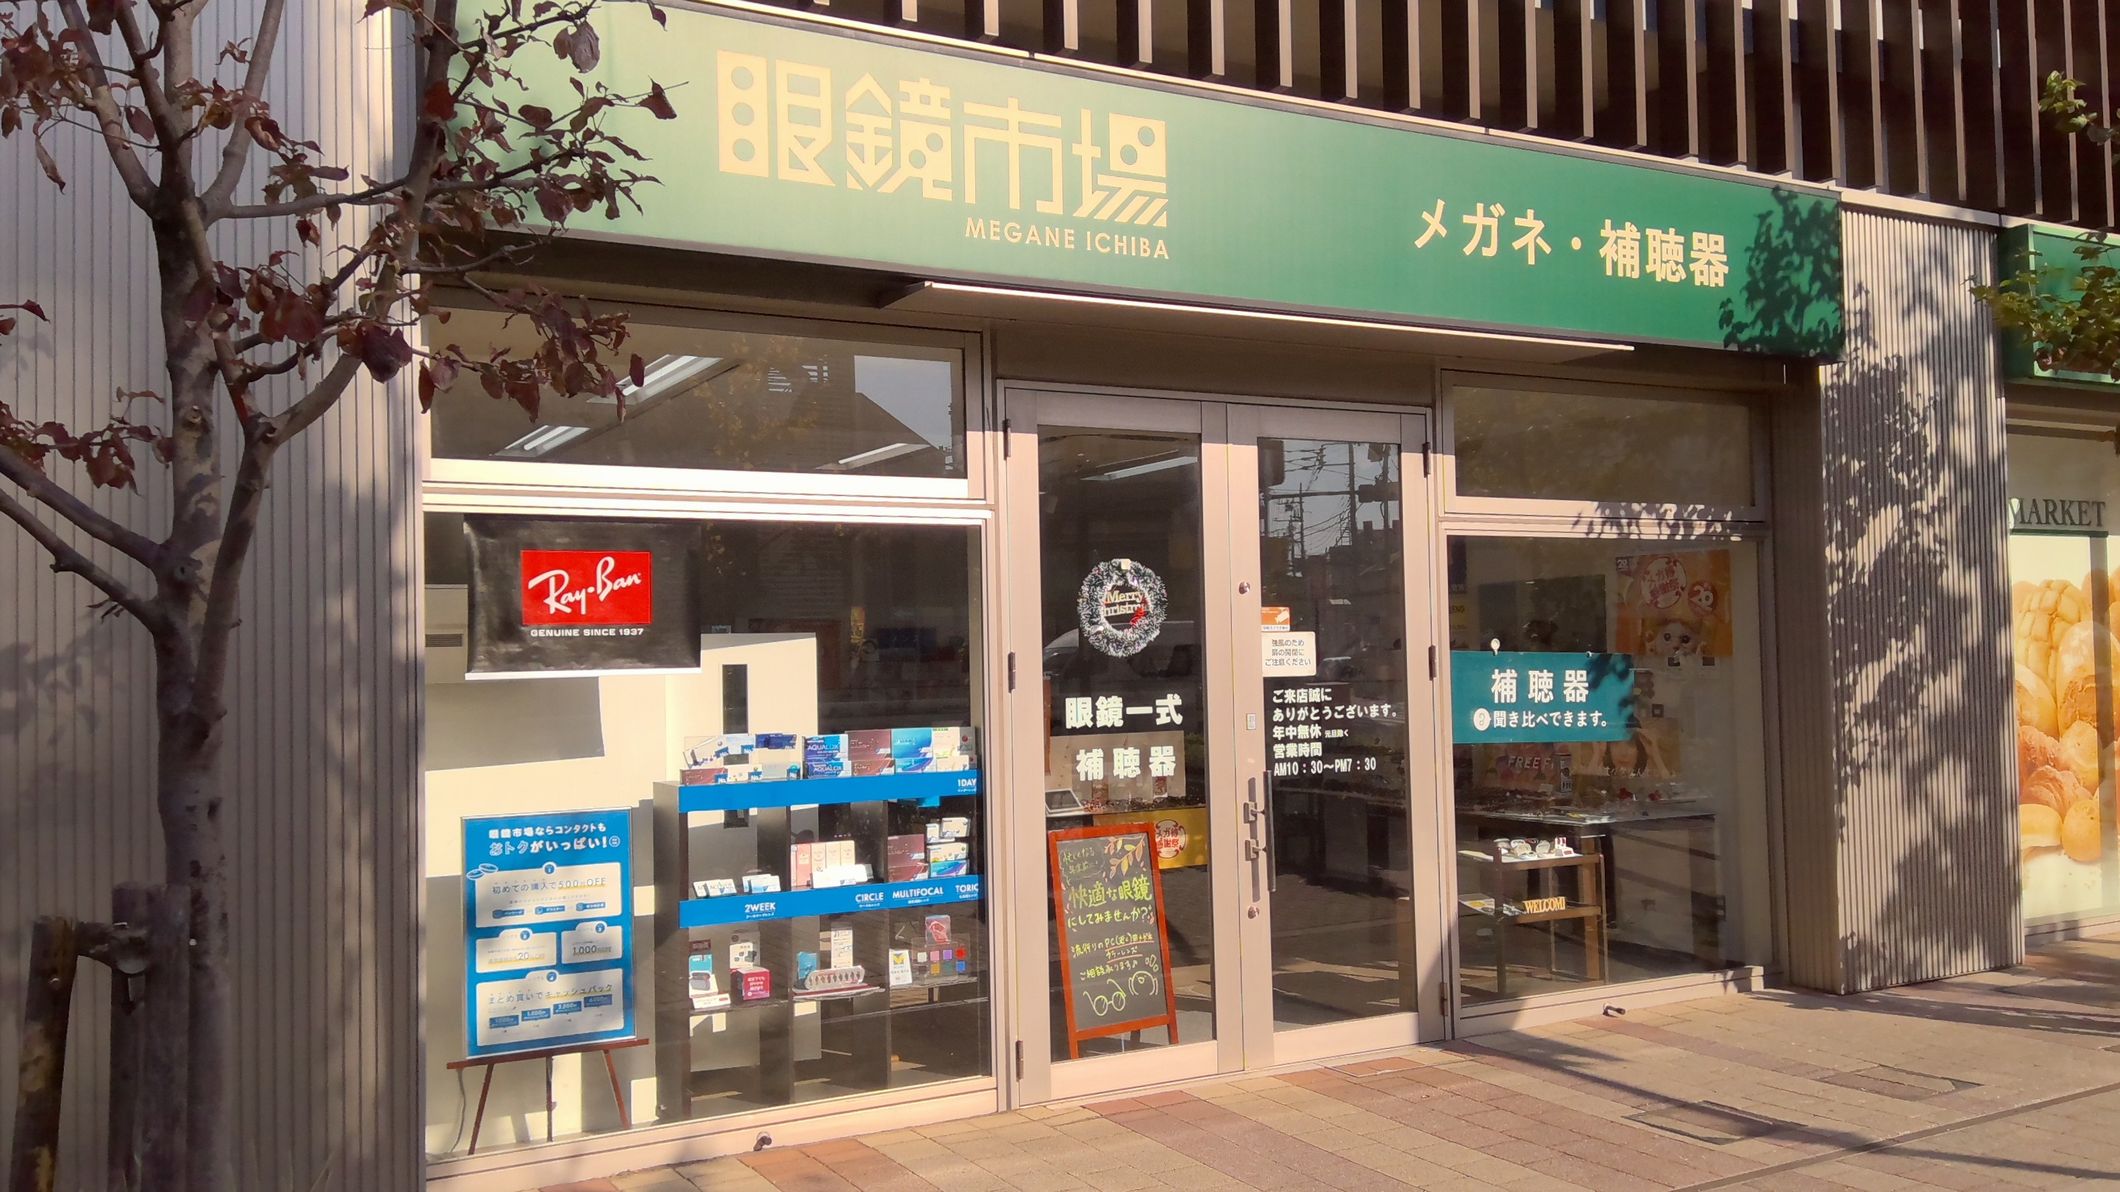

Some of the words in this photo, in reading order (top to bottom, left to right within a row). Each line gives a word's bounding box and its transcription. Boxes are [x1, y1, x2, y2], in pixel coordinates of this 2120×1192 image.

[717, 50, 1168, 227] 眼鏡市場
[965, 216, 1075, 249] MEGANE
[1086, 231, 1169, 259] ICHIBA
[2009, 497, 2106, 527] MARKET
[1103, 589, 1145, 604] Merry
[530, 628, 580, 637] GENUINE
[583, 628, 616, 637] SINCE
[618, 627, 644, 636] 1937
[1491, 668, 1589, 704] 補聴器
[1272, 688, 1332, 704] ご来店誠に
[1065, 693, 1183, 729] 眼鏡一式
[1272, 703, 1398, 722] ありがとうございます。
[1493, 710, 1608, 728] 聞き比べできます。
[1272, 724, 1322, 740] 年中無休
[1272, 742, 1323, 759] 営業時間
[1076, 745, 1177, 782] 補聴器
[1507, 756, 1540, 769] FREE
[855, 892, 884, 903] CIRCLE
[892, 886, 944, 899] MULTIFOCAL
[1068, 874, 1153, 909] 快適な眼鏡
[744, 902, 776, 913] 2WEEK
[1067, 905, 1149, 928] にしてみませんか?
